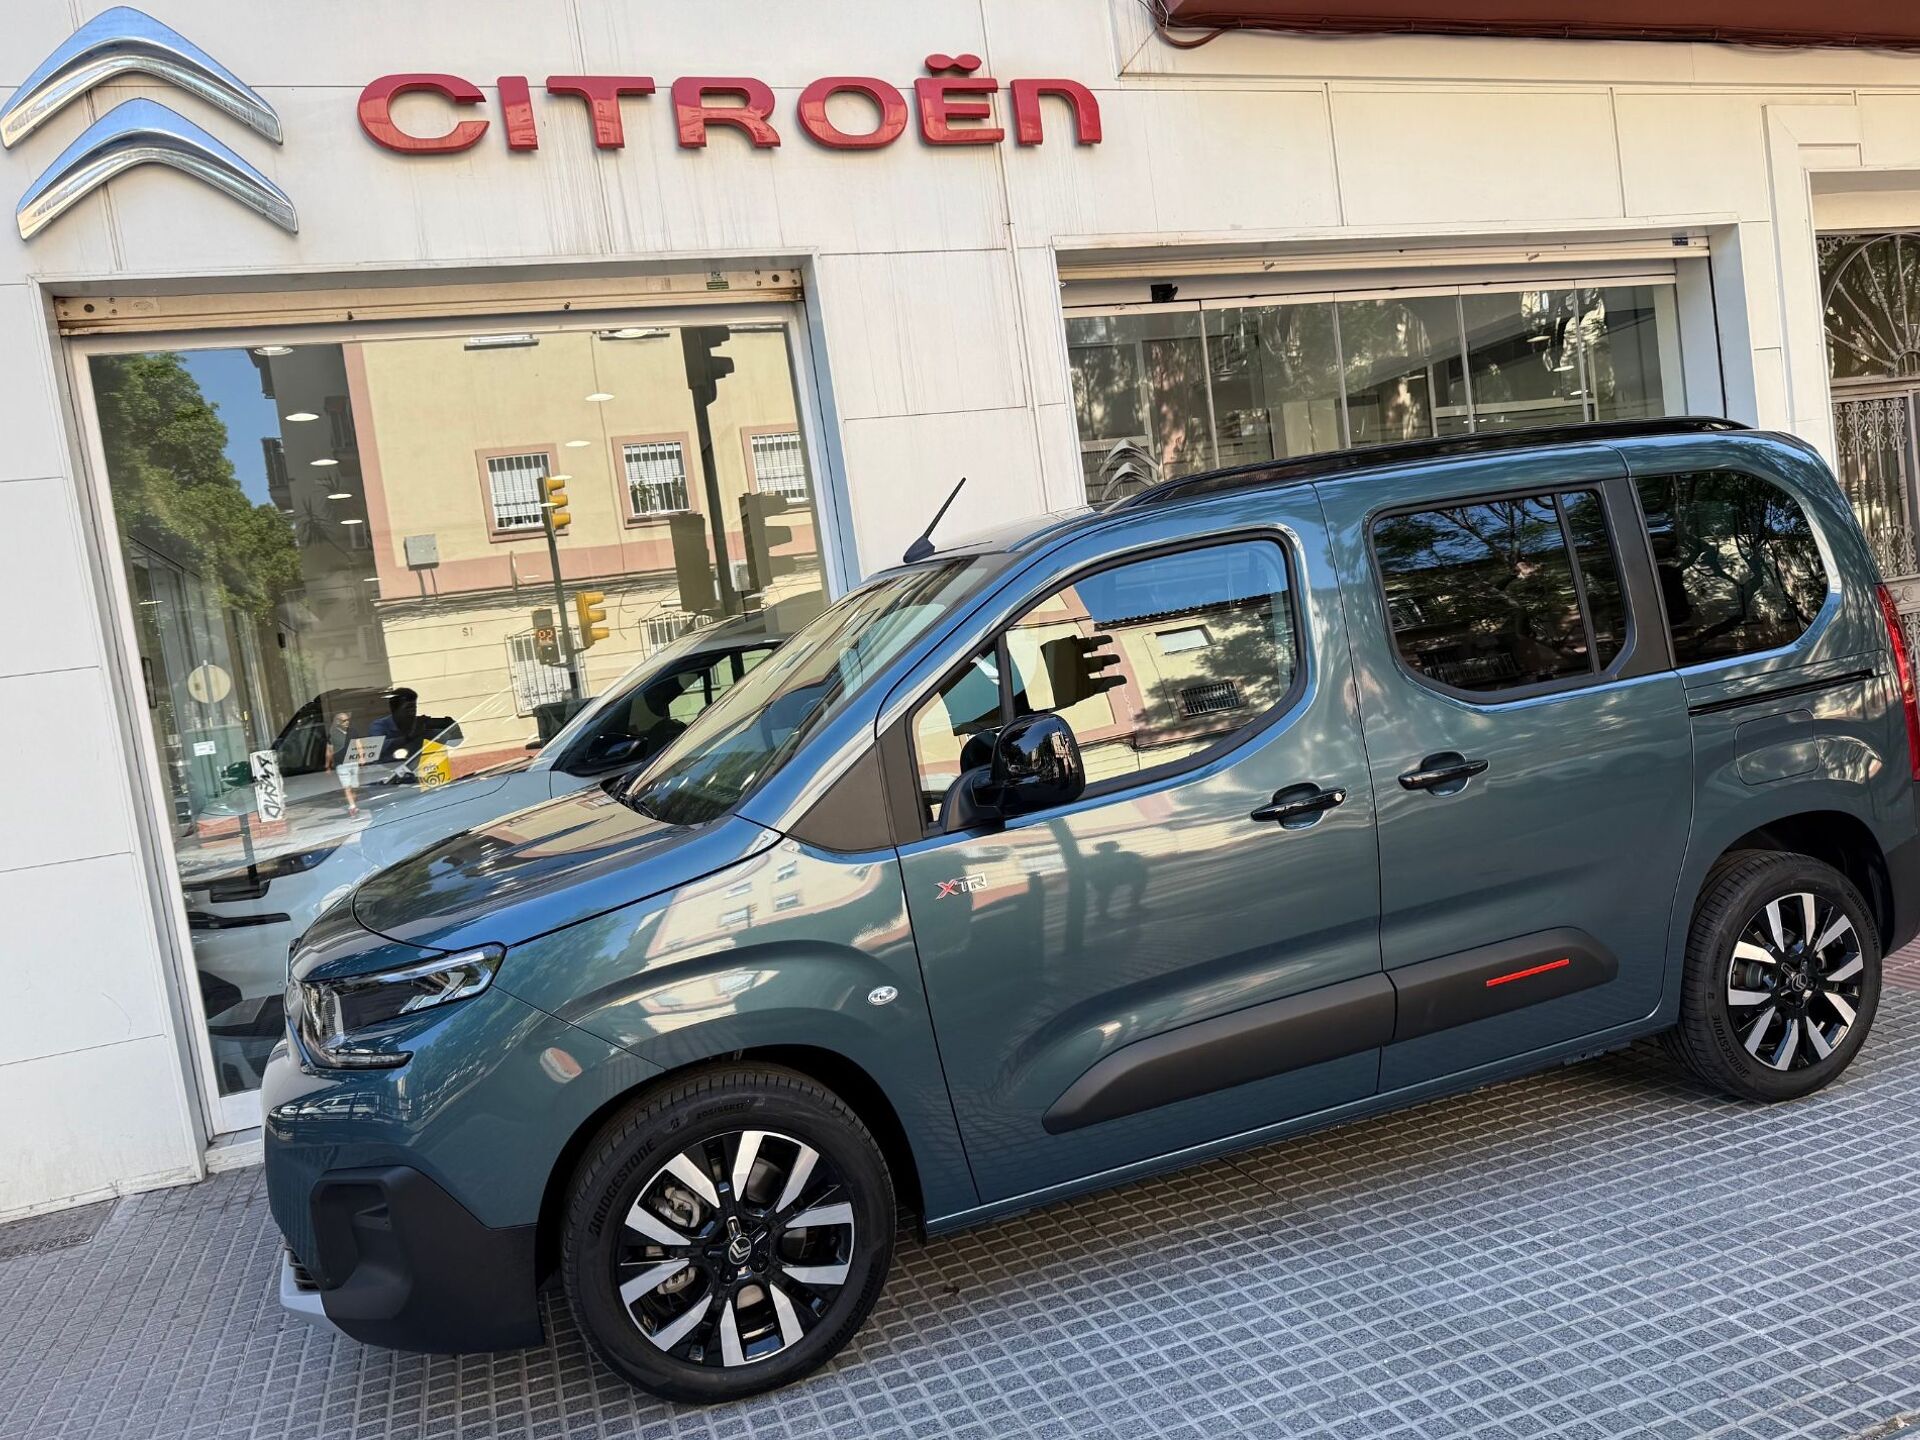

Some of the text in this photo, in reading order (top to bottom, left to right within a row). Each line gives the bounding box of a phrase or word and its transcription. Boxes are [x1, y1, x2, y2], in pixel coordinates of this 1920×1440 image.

[934, 872, 988, 900] XTR
[1711, 1014, 1750, 1078] BRIDGESTONE
[588, 1138, 657, 1237] BRIDGESTONE
